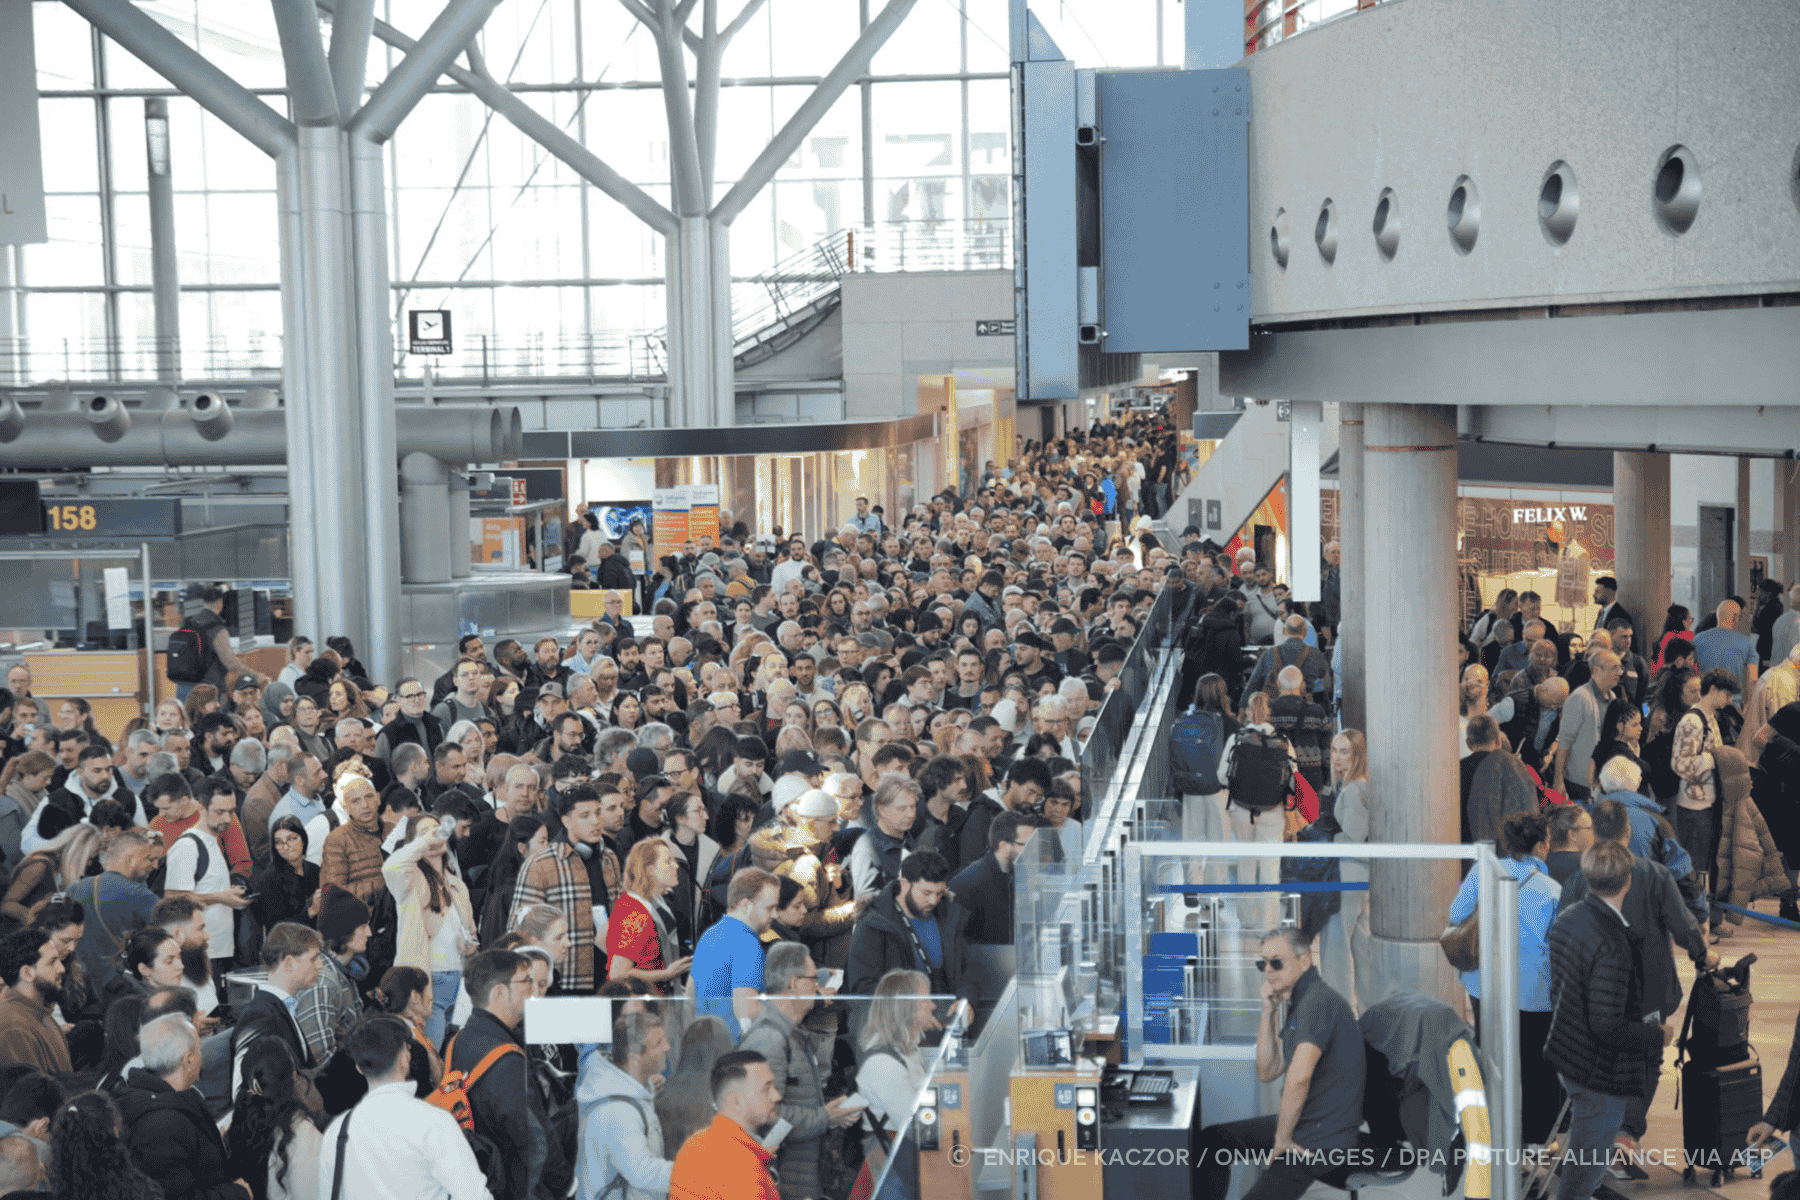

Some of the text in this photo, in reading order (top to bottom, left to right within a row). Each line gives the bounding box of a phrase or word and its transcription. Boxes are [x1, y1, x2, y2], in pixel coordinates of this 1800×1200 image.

[48, 505, 97, 530] 158
[1513, 506, 1587, 523] FELIX W.
